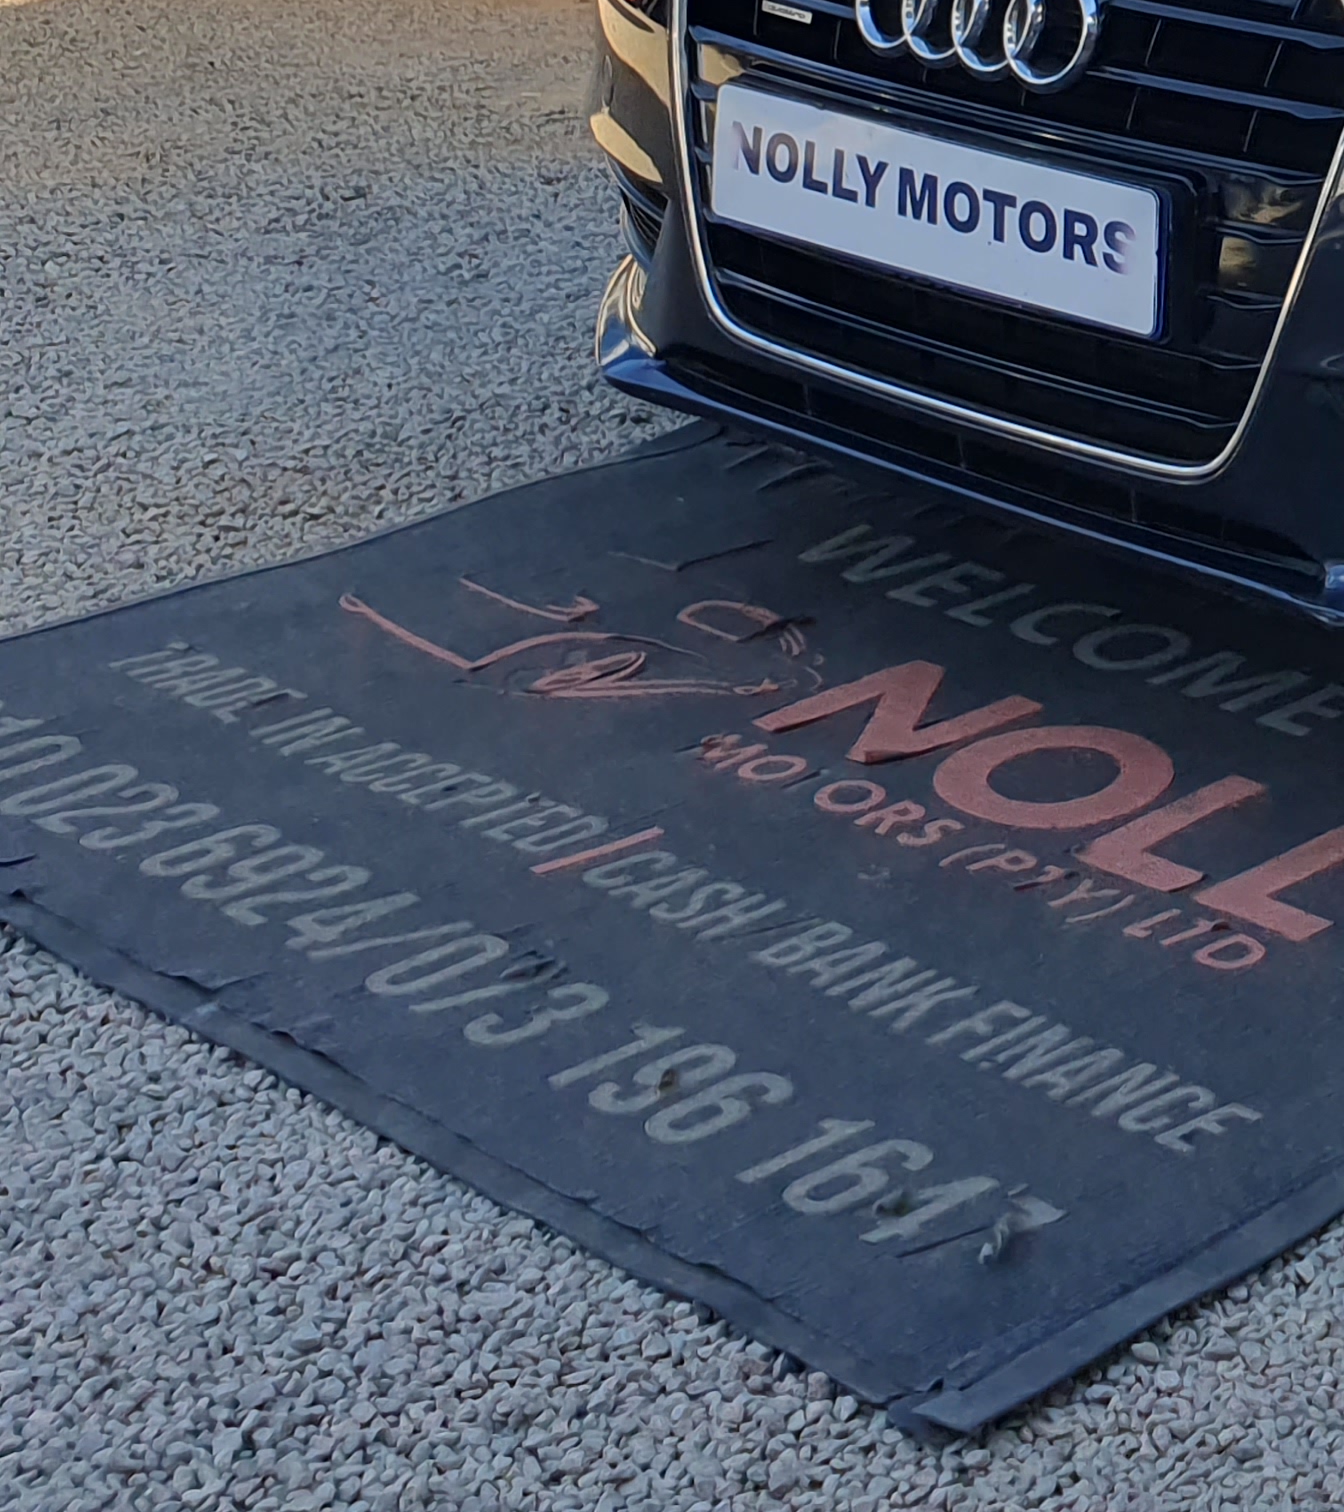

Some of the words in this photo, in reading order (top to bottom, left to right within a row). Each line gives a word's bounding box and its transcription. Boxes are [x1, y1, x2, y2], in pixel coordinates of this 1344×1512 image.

[731, 122, 890, 209] NOLLY
[897, 168, 1136, 275] MOTORS
[697, 732, 966, 848] MOORS
[108, 640, 309, 725] TRADE
[249, 707, 366, 757] IN
[925, 999, 1264, 1154] FINANCE
[547, 1022, 794, 1145] 196
